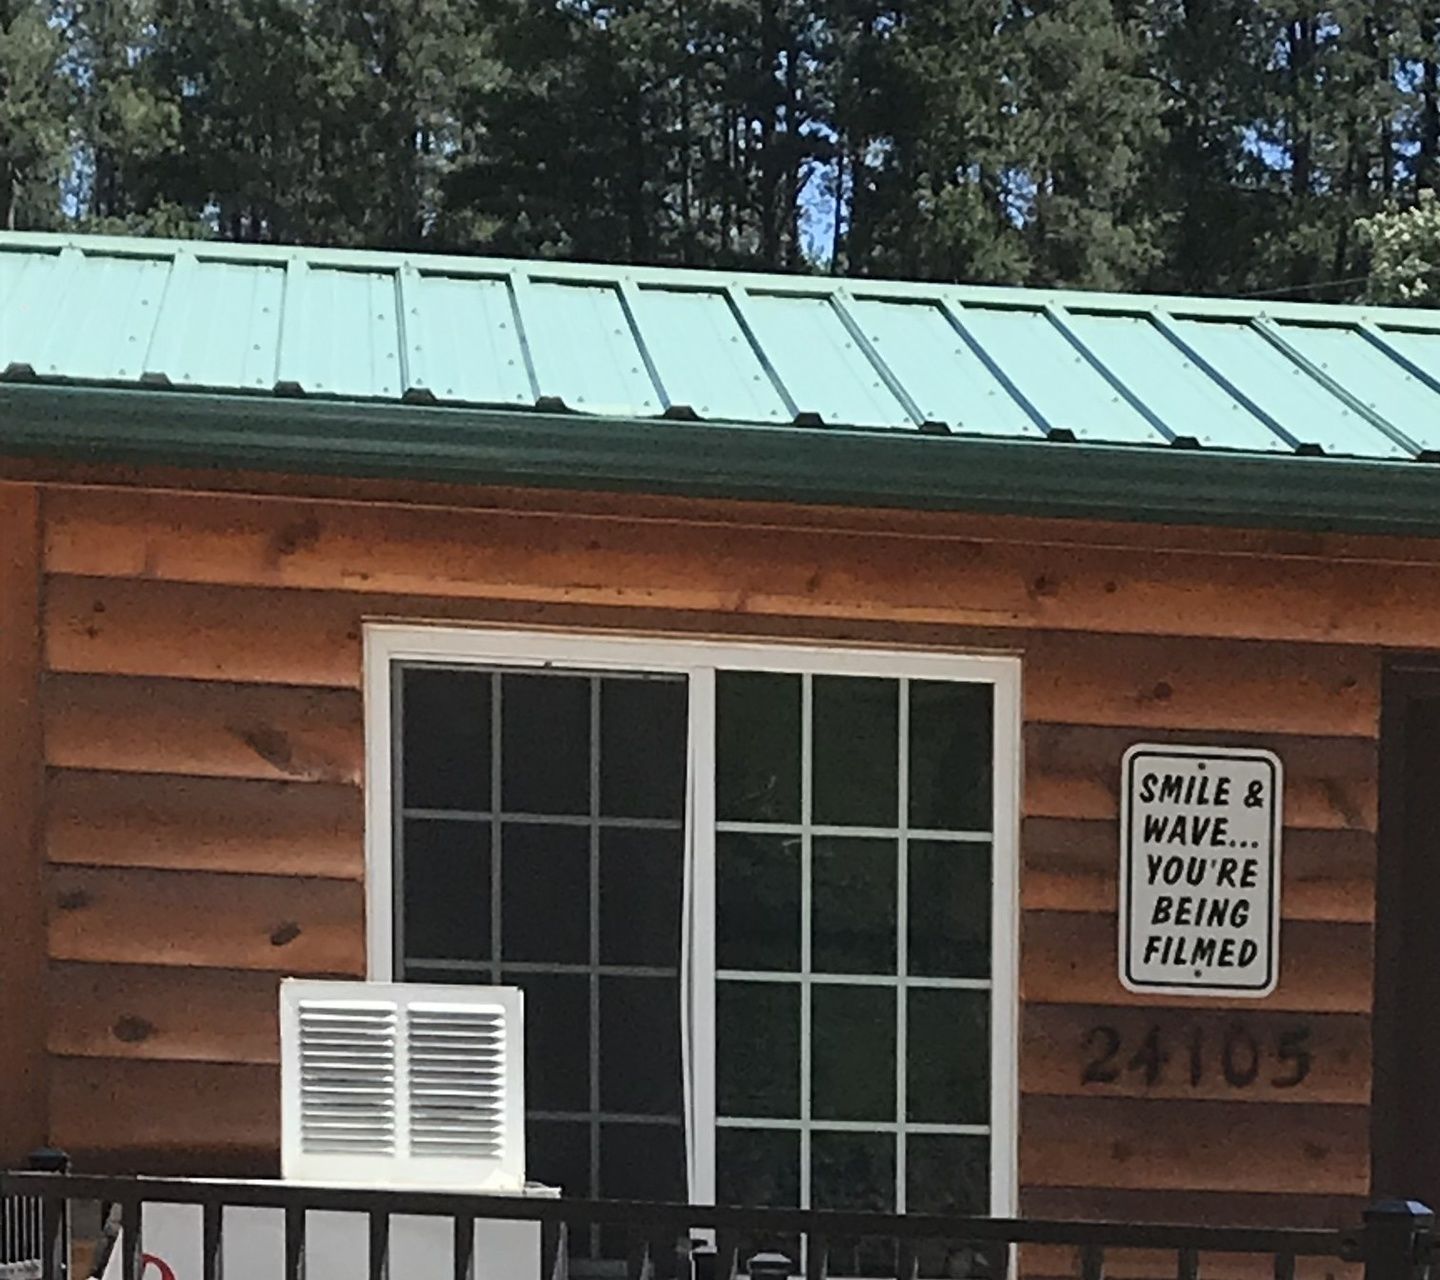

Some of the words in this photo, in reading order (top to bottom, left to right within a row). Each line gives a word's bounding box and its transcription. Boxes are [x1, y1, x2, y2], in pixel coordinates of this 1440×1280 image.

[1139, 773, 1231, 806] SMILE
[1243, 779, 1265, 808] &
[1143, 815, 1259, 849] WAVE...
[1147, 854, 1258, 888] YOU'RE
[1151, 896, 1250, 927] BEING
[1142, 935, 1258, 967] FILMED
[1081, 1024, 1312, 1089] 24105
